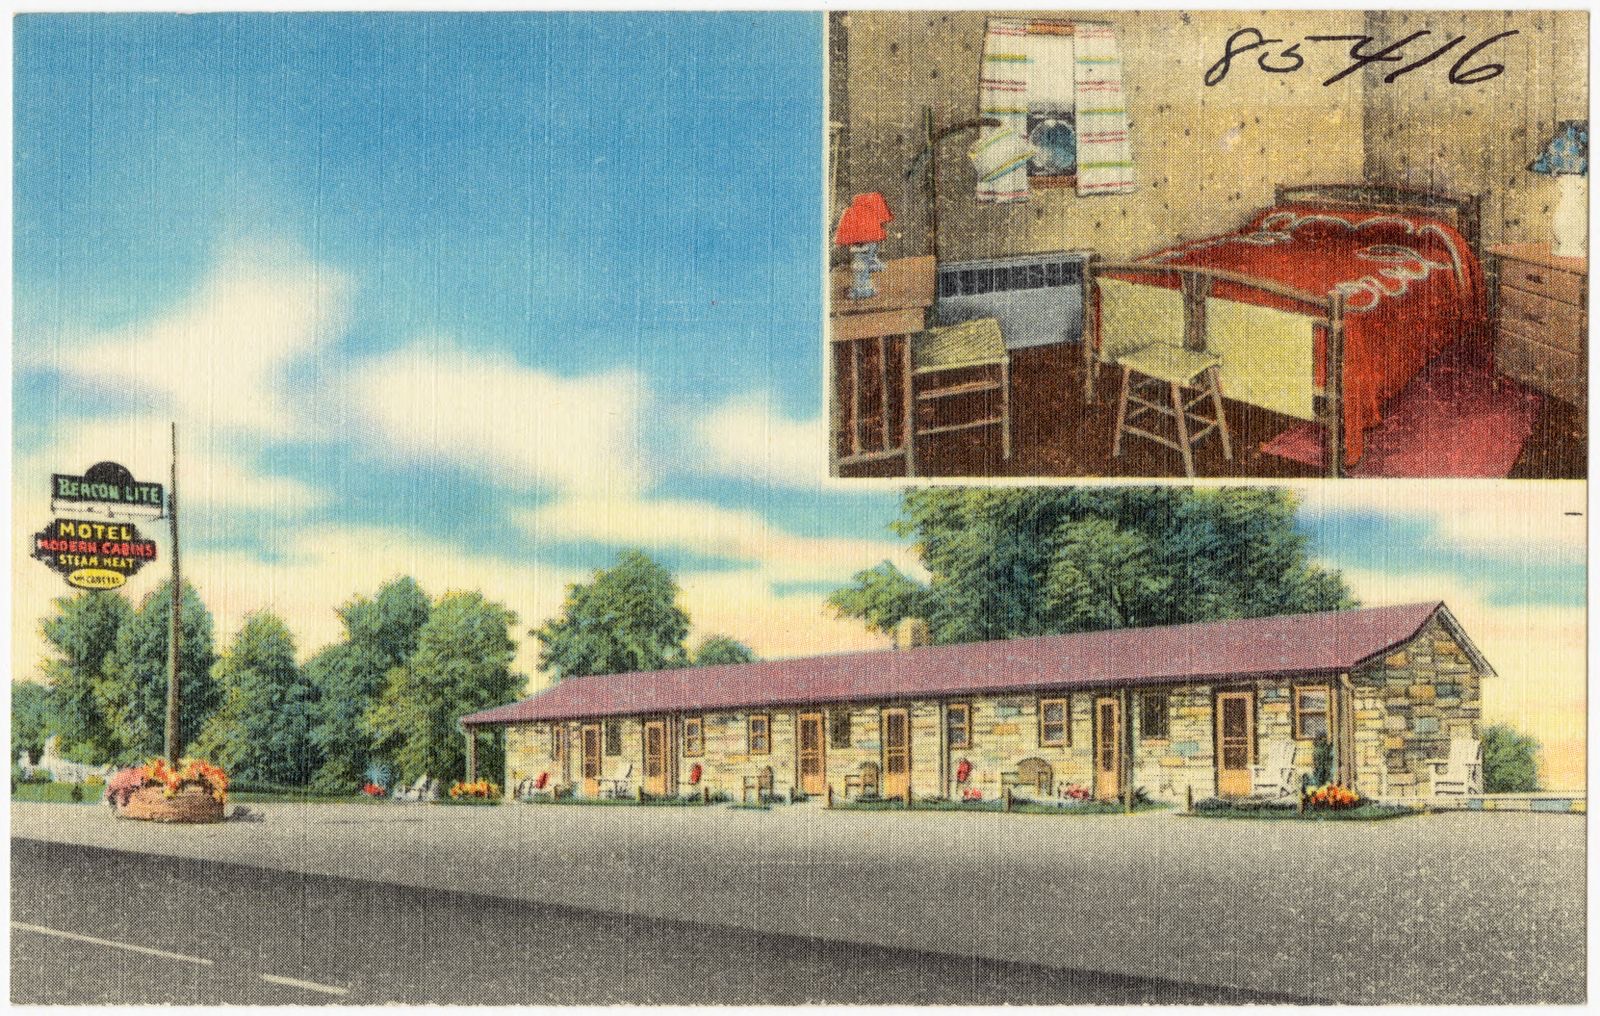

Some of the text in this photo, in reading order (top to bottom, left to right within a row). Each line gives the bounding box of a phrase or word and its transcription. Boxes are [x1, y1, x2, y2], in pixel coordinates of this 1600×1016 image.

[1204, 27, 1520, 87] 85416
[57, 478, 161, 504] BEACON LITE
[59, 522, 132, 541] MOTEL
[37, 539, 153, 557] MODERN CABINS
[59, 554, 99, 566] STEAM
